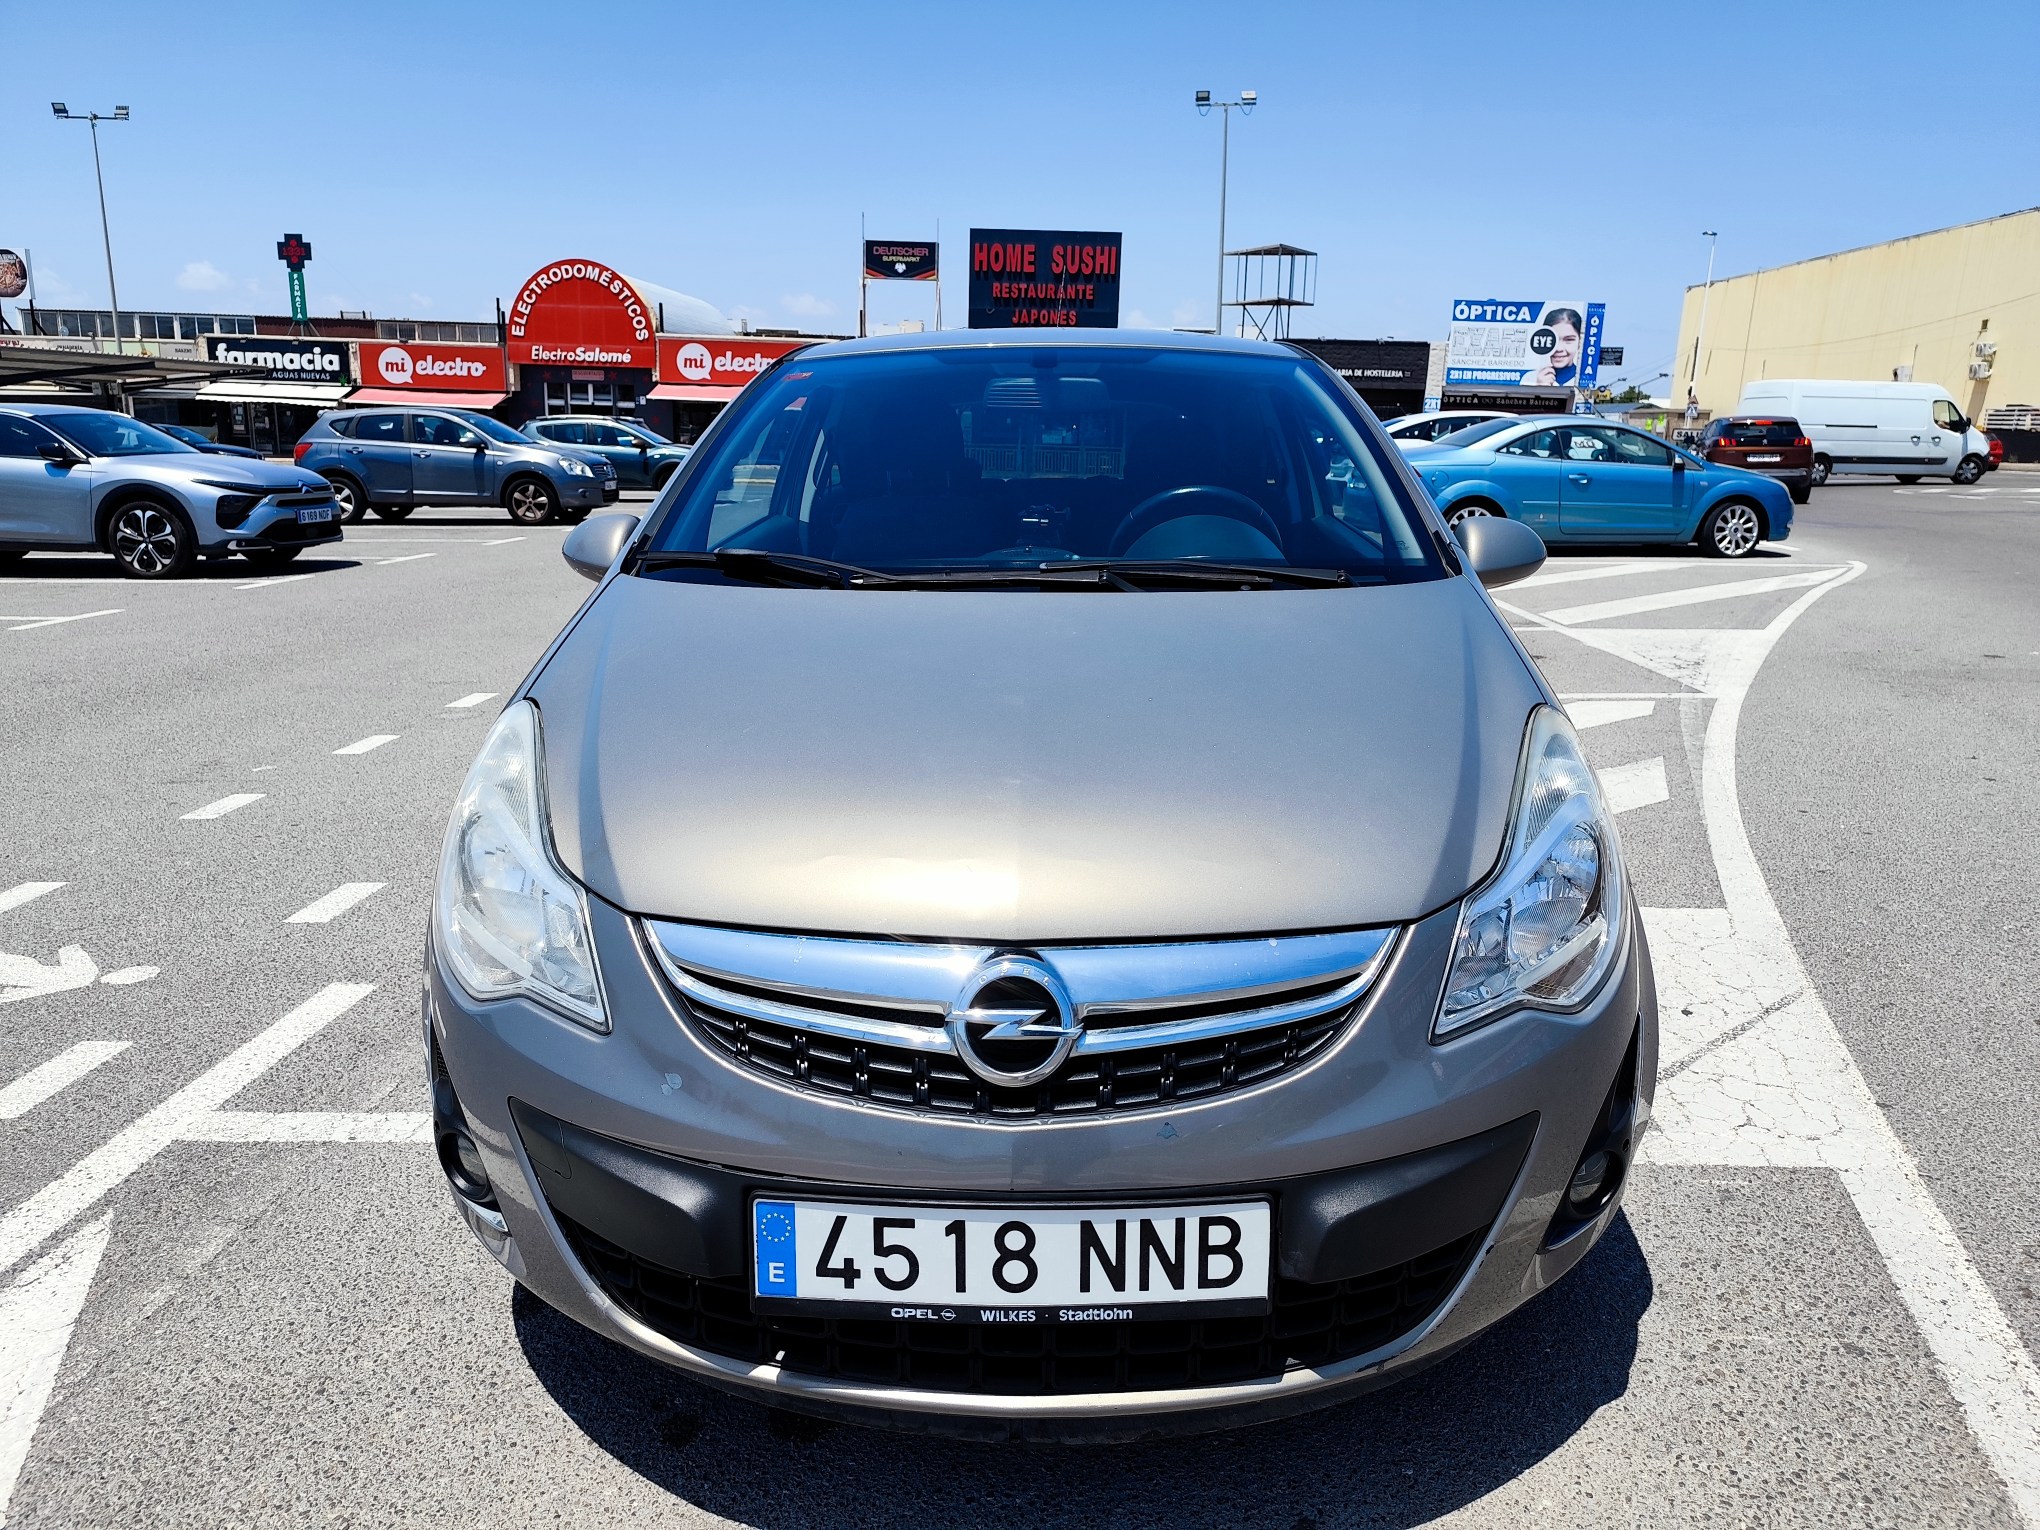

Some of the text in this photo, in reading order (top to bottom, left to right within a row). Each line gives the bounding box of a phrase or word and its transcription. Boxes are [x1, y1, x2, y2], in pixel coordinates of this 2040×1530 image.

[873, 246, 929, 256] DEUTSCHER
[974, 243, 1117, 275] HOME SUSHI
[293, 273, 303, 319] FARMACIA
[992, 282, 1094, 300] RESTAURANTE
[511, 264, 649, 341] ELECTRODOMÉSTICOS
[1454, 301, 1532, 322] ÓPTICA
[1012, 309, 1077, 326] JAPONES
[1533, 336, 1553, 348] EYE
[215, 342, 340, 371] farmacia
[531, 345, 632, 363] ElectroSalomé
[683, 350, 779, 373] mi electr
[385, 354, 487, 377] mi electro
[1354, 368, 1363, 377] DE
[272, 371, 331, 380] AGUAS NUEVAS
[768, 1214, 1244, 1294] E 4518 NNB
[890, 1307, 1133, 1322] OPEL WILKES Stadtlohn
